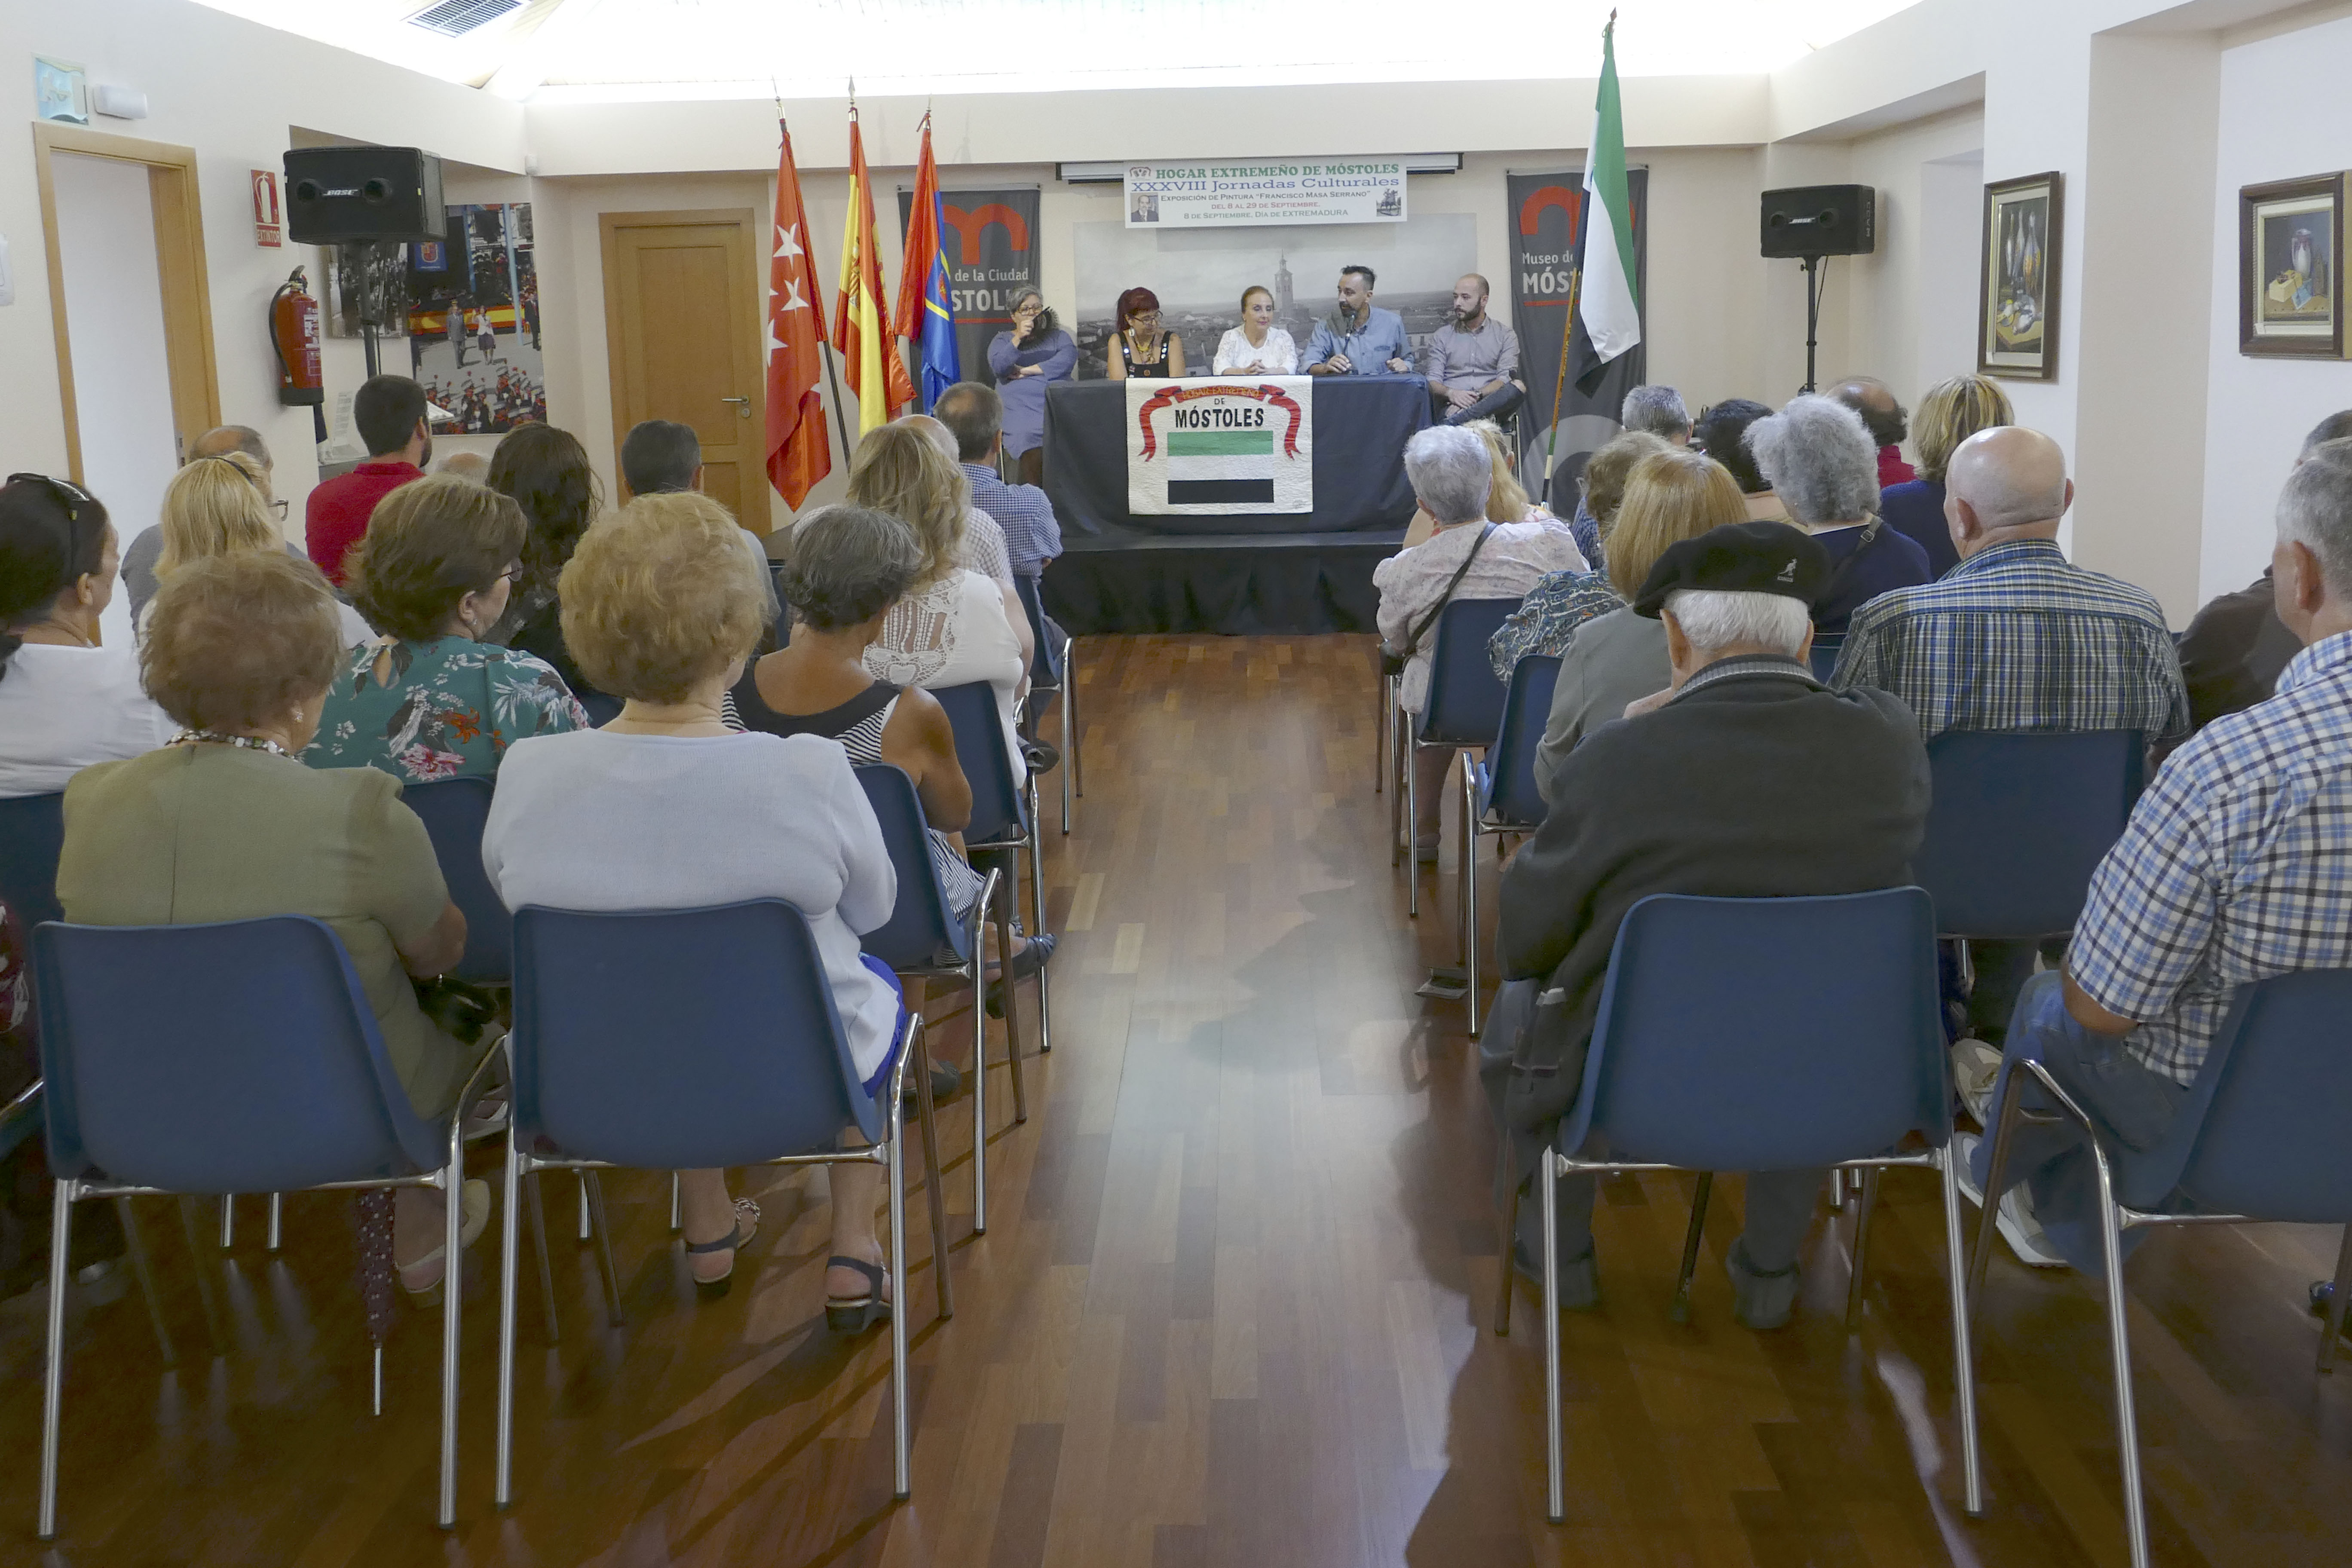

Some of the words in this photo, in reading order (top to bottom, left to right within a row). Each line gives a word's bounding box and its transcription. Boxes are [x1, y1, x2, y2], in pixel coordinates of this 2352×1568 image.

[1156, 168, 1207, 179] HOGAR
[1211, 164, 1298, 178] EXTREMEÑO
[1302, 166, 1322, 175] DE
[1325, 163, 1400, 175] MÓSTOLES
[1131, 181, 1207, 192] XXXVIII
[1211, 179, 1295, 193] Jornadas
[1302, 177, 1400, 188] Culturales
[1522, 253, 1558, 264] Museo
[955, 269, 969, 282] de
[973, 269, 984, 281] la
[989, 268, 1029, 281] Ciudad
[1183, 387, 1210, 400] HOGAR
[1175, 405, 1264, 428] MÓSTOLES
